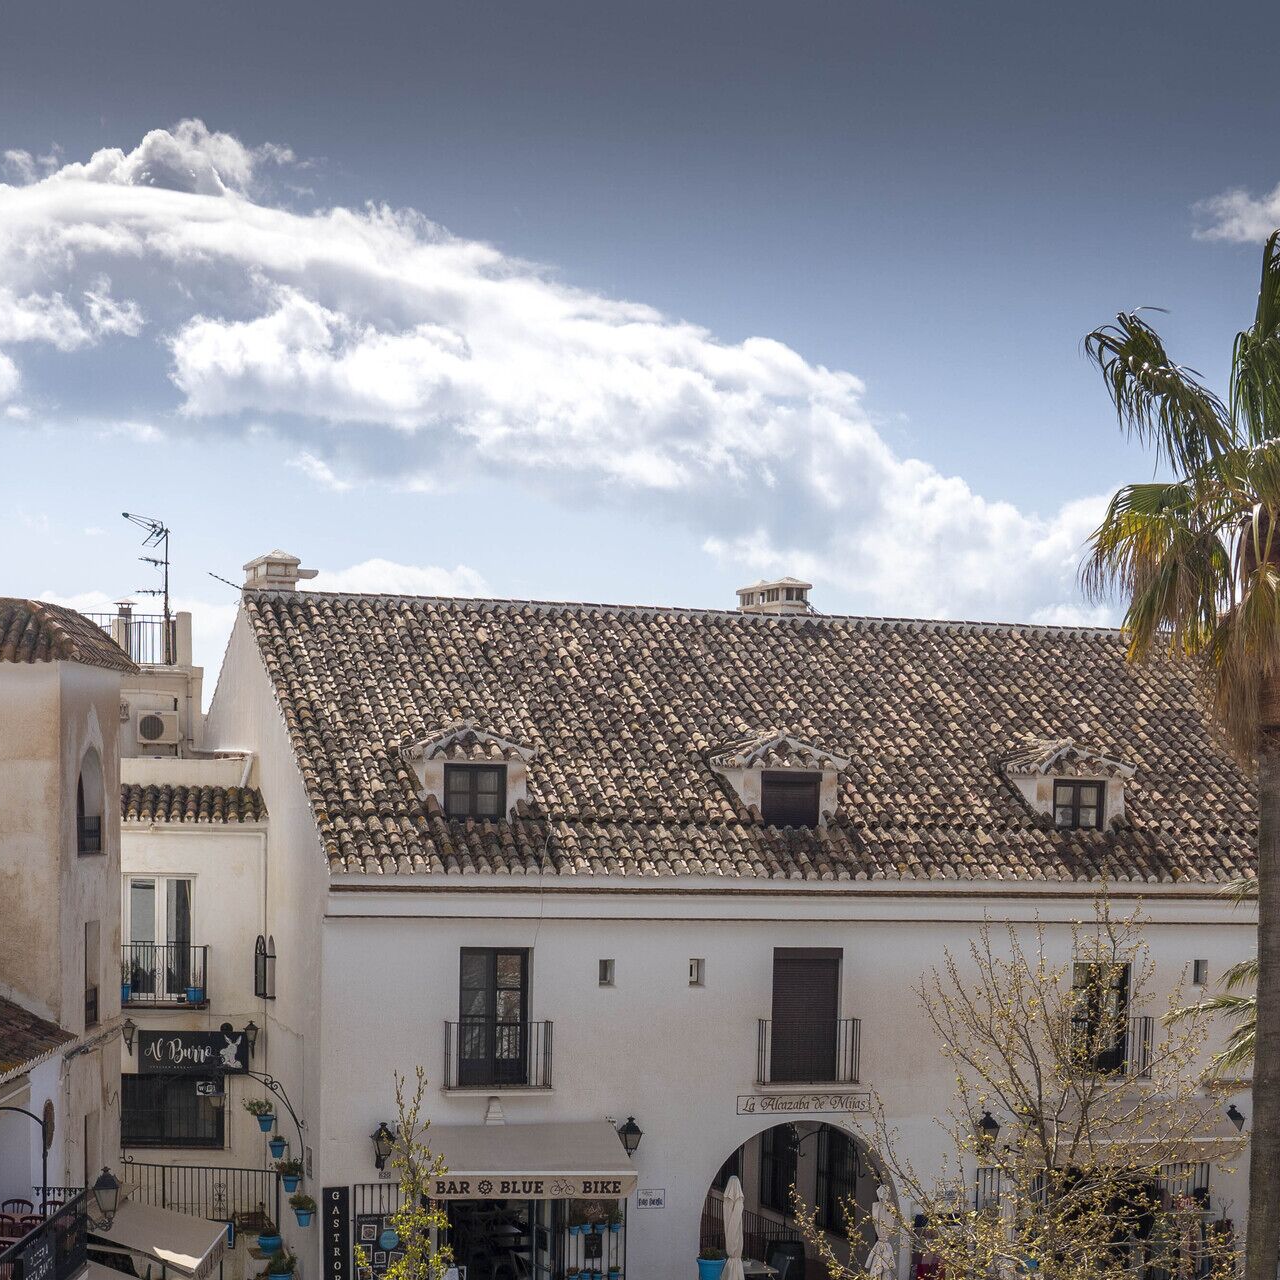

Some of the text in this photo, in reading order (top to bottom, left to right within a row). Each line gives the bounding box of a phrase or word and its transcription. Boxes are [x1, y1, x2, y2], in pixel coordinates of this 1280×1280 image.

[144, 1038, 213, 1064] Al Burro
[742, 1095, 866, 1113] La Alcazaba de Mijas
[435, 1180, 622, 1195] BAR BLUE BIKE
